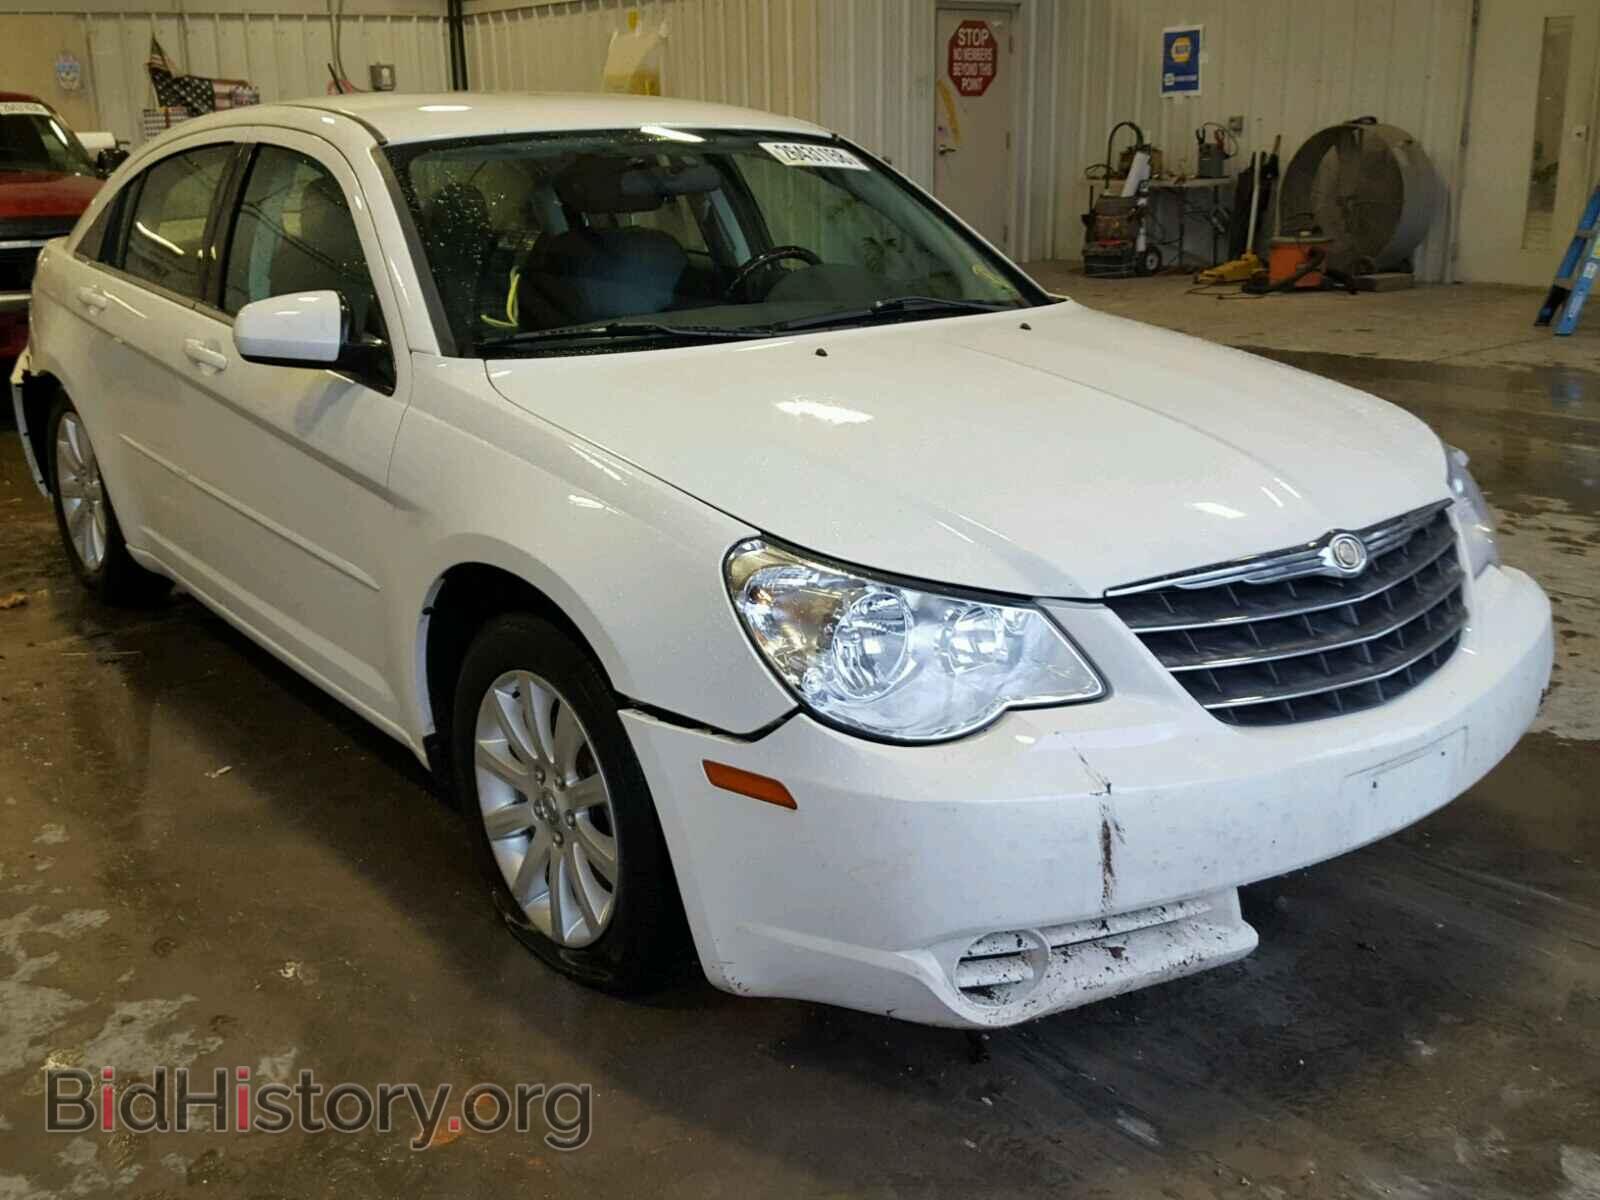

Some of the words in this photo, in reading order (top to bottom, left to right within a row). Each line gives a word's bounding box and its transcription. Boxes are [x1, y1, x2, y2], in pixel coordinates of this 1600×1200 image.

[958, 28, 989, 46] STOP
[953, 63, 977, 76] BEYOND
[979, 62, 993, 76] THIS
[962, 78, 983, 91] POINT
